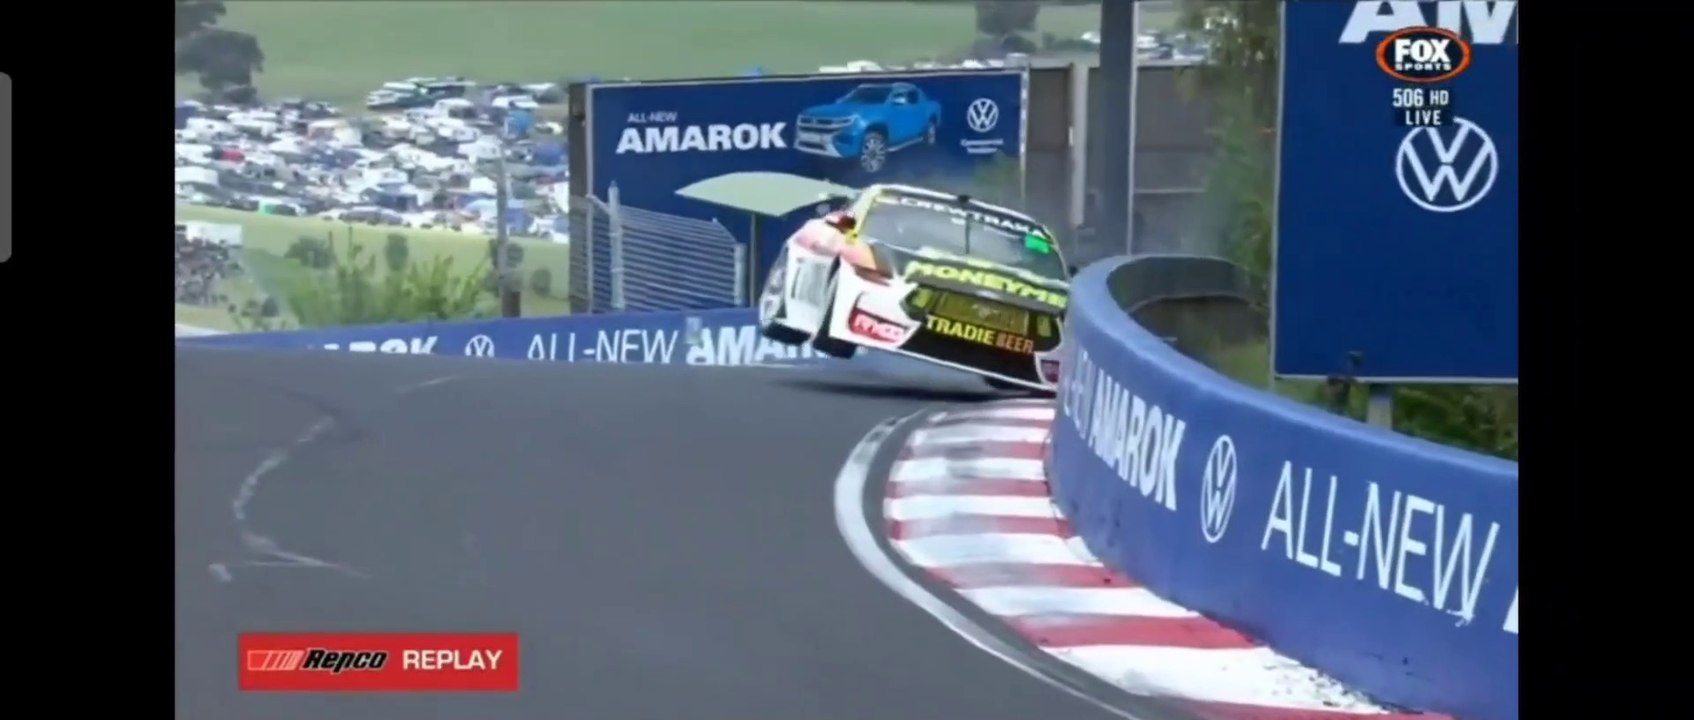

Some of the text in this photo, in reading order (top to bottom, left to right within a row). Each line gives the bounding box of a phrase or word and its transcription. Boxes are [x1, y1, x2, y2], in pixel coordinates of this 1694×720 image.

[627, 111, 678, 123] ALL-NEW
[615, 122, 788, 154] AMAROK
[926, 315, 995, 346] TRADIE
[1087, 367, 1187, 512] AMAROK
[1261, 459, 1500, 628] ALL-NEW
